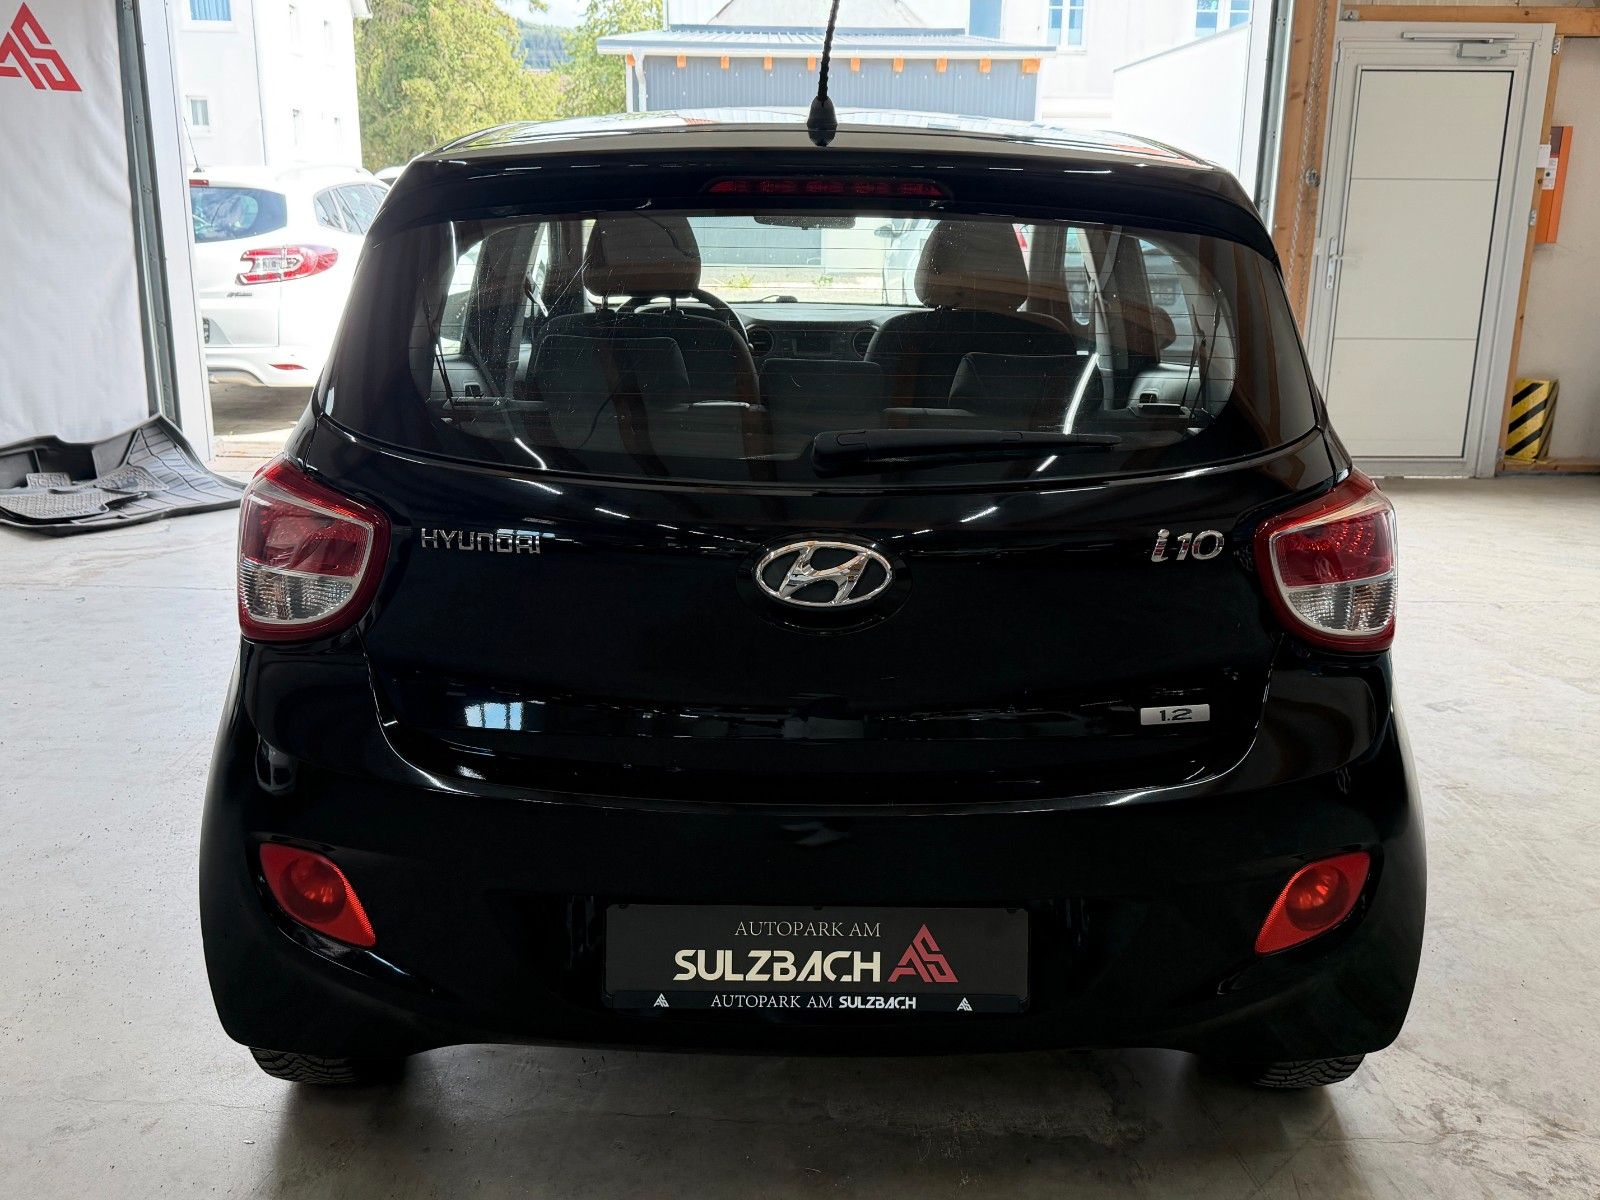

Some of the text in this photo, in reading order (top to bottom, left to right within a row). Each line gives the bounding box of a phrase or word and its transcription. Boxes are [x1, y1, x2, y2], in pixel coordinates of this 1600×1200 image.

[421, 528, 541, 554] HYUNDAI
[1151, 528, 1225, 563] i10
[1159, 707, 1193, 722] 1.2
[734, 921, 881, 938] AUTOPARK AM
[673, 949, 881, 983] SULZBACH
[710, 994, 917, 1010] AUTOPARK AM SULZBACH
